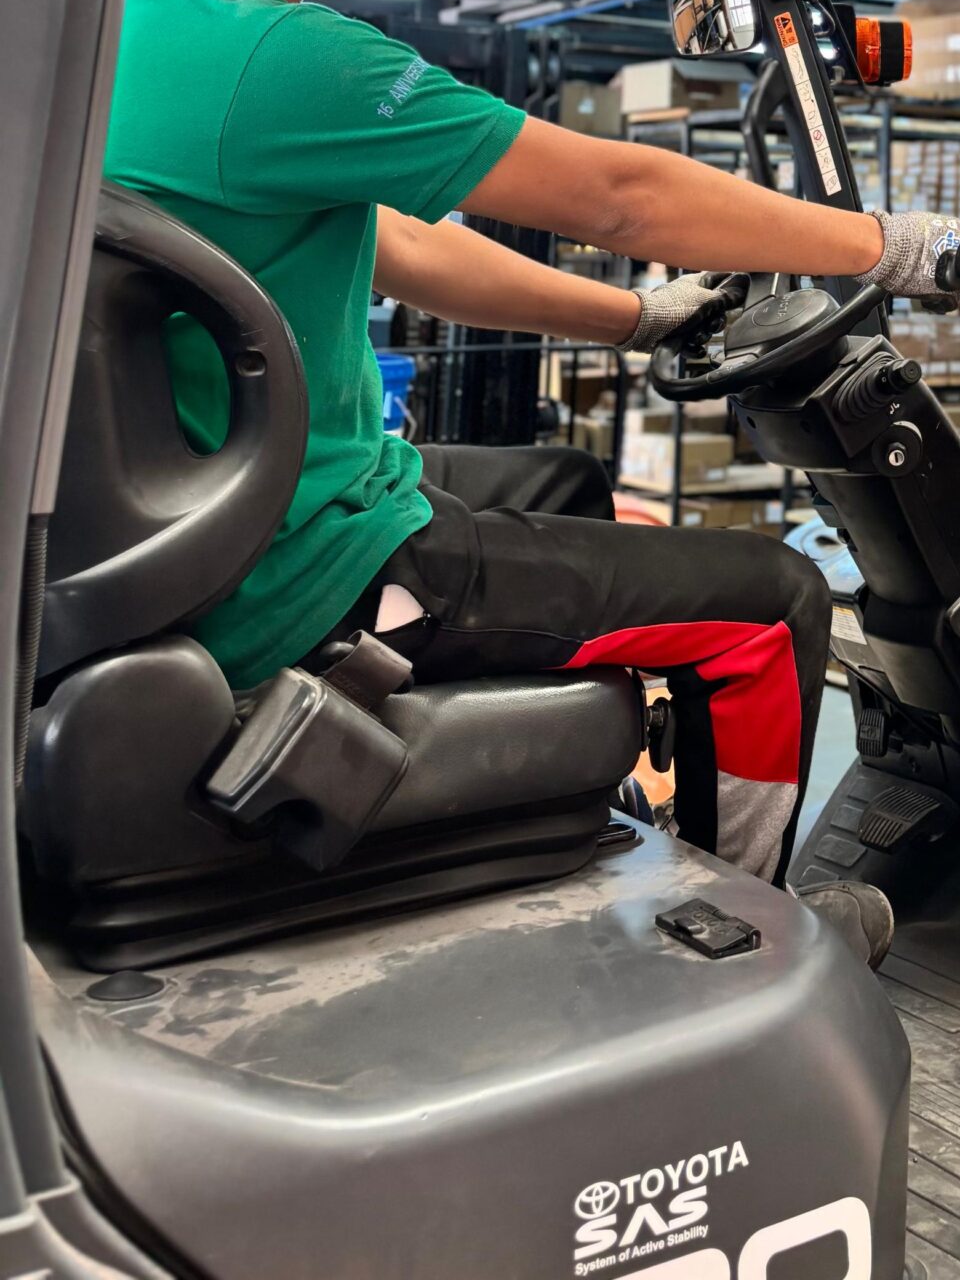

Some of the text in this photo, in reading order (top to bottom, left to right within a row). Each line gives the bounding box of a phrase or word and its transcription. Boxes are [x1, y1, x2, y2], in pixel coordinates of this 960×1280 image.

[377, 101, 394, 119] 15
[620, 1140, 749, 1204] TOYOTA
[574, 1186, 708, 1260] SAS
[574, 1255, 616, 1276] System
[618, 1248, 630, 1261] of
[631, 1239, 665, 1258] Active
[667, 1225, 709, 1246] Stability
